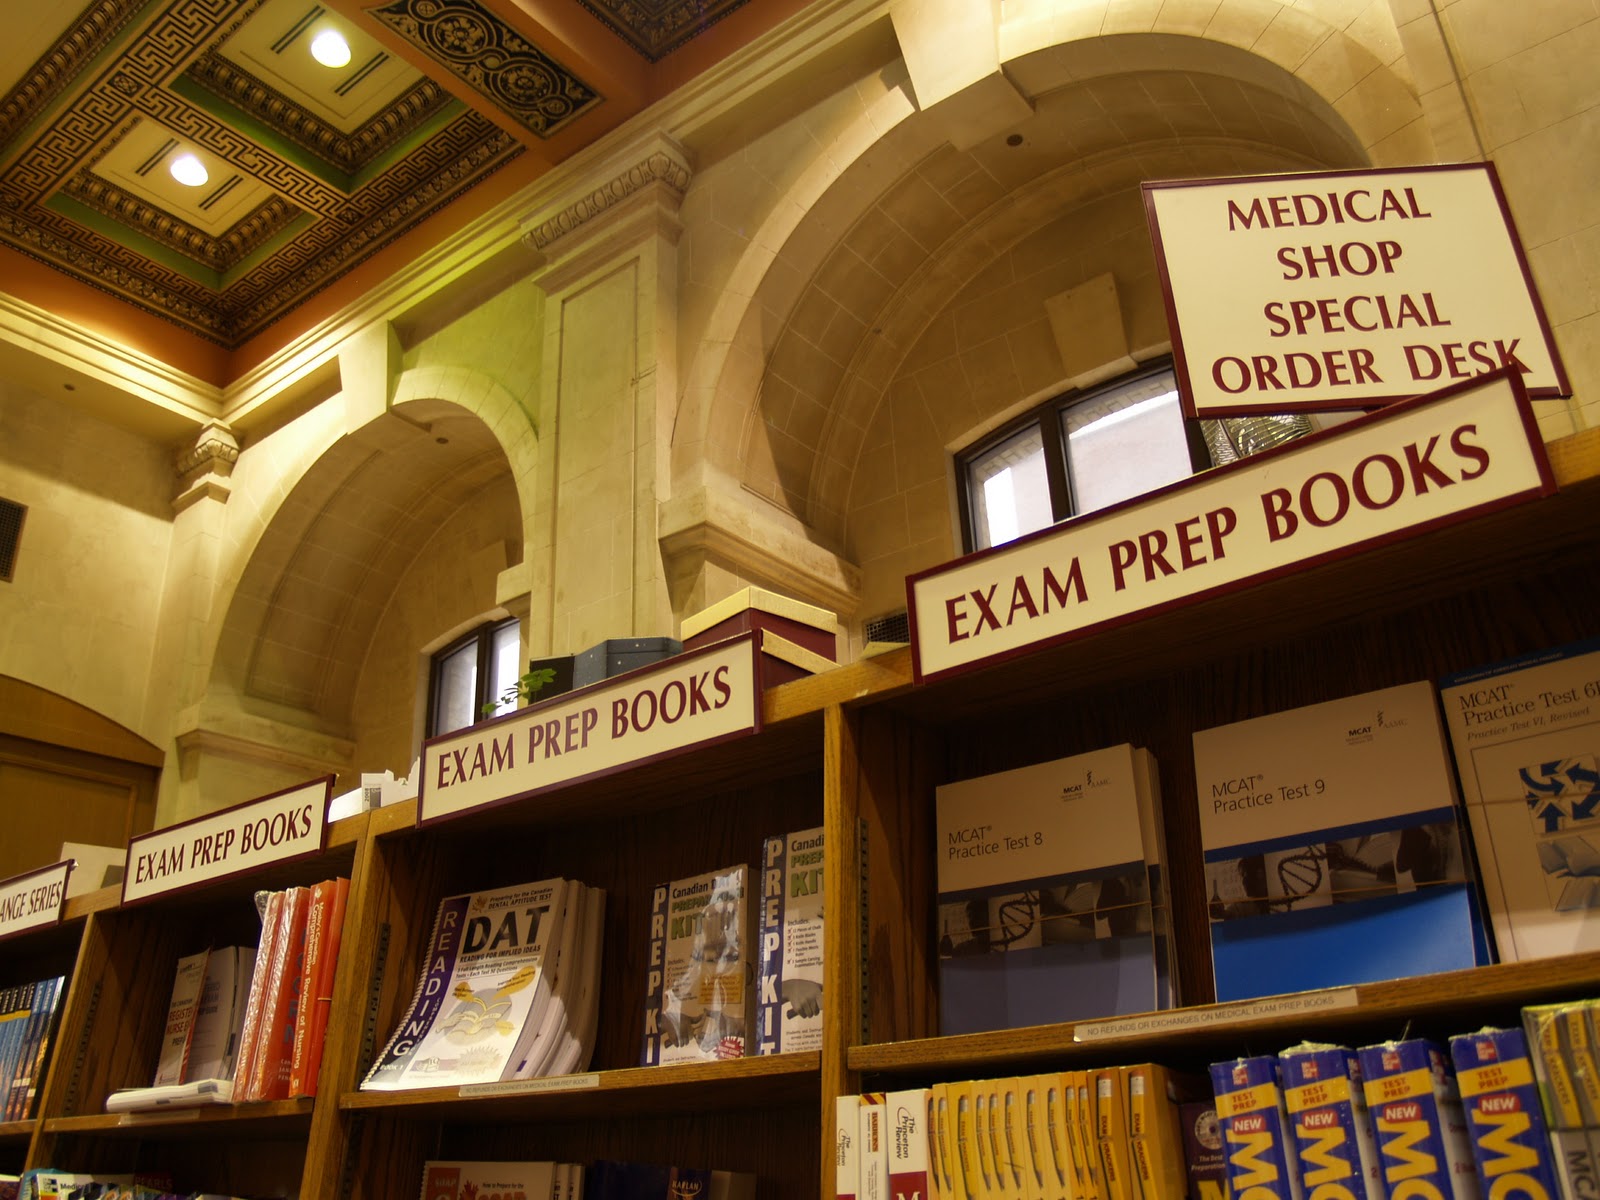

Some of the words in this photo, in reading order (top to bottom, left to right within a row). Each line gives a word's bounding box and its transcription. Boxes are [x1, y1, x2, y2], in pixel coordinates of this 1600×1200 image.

[1227, 187, 1431, 231] MEDICAL
[1277, 240, 1403, 281] SHOP
[1263, 292, 1451, 337] SPECIAL
[1211, 348, 1384, 394] ORDER
[1403, 338, 1533, 383] DESK
[945, 556, 1089, 644] EXAM
[1107, 507, 1238, 592] PREP
[1260, 424, 1490, 542] BOOKS
[1462, 699, 1535, 726] Practice
[1538, 687, 1580, 708] Test
[1467, 726, 1507, 741] Practice
[1509, 721, 1529, 732] Test
[1549, 706, 1591, 723] Revised
[437, 733, 514, 790] EXAM
[527, 707, 598, 764] PREP
[611, 665, 731, 740] BOOKS
[1349, 726, 1372, 737] MCAT
[1063, 784, 1083, 795] MCAT
[1213, 792, 1273, 814] Practice
[1278, 783, 1310, 801] Test
[1314, 779, 1325, 794] 9
[135, 843, 185, 884] EXAM
[190, 829, 235, 868] PREP
[240, 804, 313, 855] BOOKS
[949, 842, 1000, 860] Practice
[1003, 835, 1030, 851] Test
[1033, 831, 1043, 846] 8
[27, 880, 62, 916] SERIES
[488, 901, 509, 910] DENTAL
[510, 896, 538, 906] APTITUDE
[539, 893, 552, 901] TEST
[673, 882, 708, 898] Canadian
[763, 839, 783, 962] PREP
[305, 904, 319, 976] Comprehensive
[462, 905, 550, 954] DAT
[647, 887, 667, 997] PREP
[671, 912, 705, 940] KIT
[460, 953, 485, 963] READING
[486, 951, 497, 960] FOR
[498, 947, 522, 957] IMPLIED
[523, 944, 541, 952] IDEAS
[301, 977, 312, 1013] Review
[392, 911, 458, 1057] READING
[299, 1015, 305, 1027] of
[1087, 1027, 1099, 1036] NO
[1100, 1022, 1136, 1034] REFUNDS
[1138, 1021, 1149, 1029] OR
[1150, 1015, 1199, 1028] EXCHANGES
[1200, 1012, 1213, 1022] ON
[1215, 1009, 1250, 1020] MEDICAL
[1253, 1004, 1277, 1014] EXAM
[1279, 1001, 1301, 1011] PREP
[1304, 996, 1334, 1008] BOOKS
[293, 1030, 304, 1070] Nursing
[1301, 1085, 1324, 1097] TEST
[1382, 1077, 1406, 1089] TEST
[1476, 1067, 1502, 1080] TEST
[1478, 1076, 1508, 1089] PREP
[1232, 1091, 1253, 1103] TEST
[1232, 1100, 1257, 1112] PREP
[1302, 1093, 1328, 1106] PREP
[1383, 1086, 1410, 1098] PREP
[1481, 1096, 1516, 1112] NEW
[1234, 1118, 1262, 1132] NEW
[1304, 1112, 1333, 1127] NEW
[1385, 1105, 1417, 1120] NEW
[1103, 1143, 1116, 1182] KRACKERS
[1136, 1141, 1149, 1181] KRACKERS
[1567, 1151, 1595, 1200] MC
[672, 1180, 699, 1190] KAPLAN
